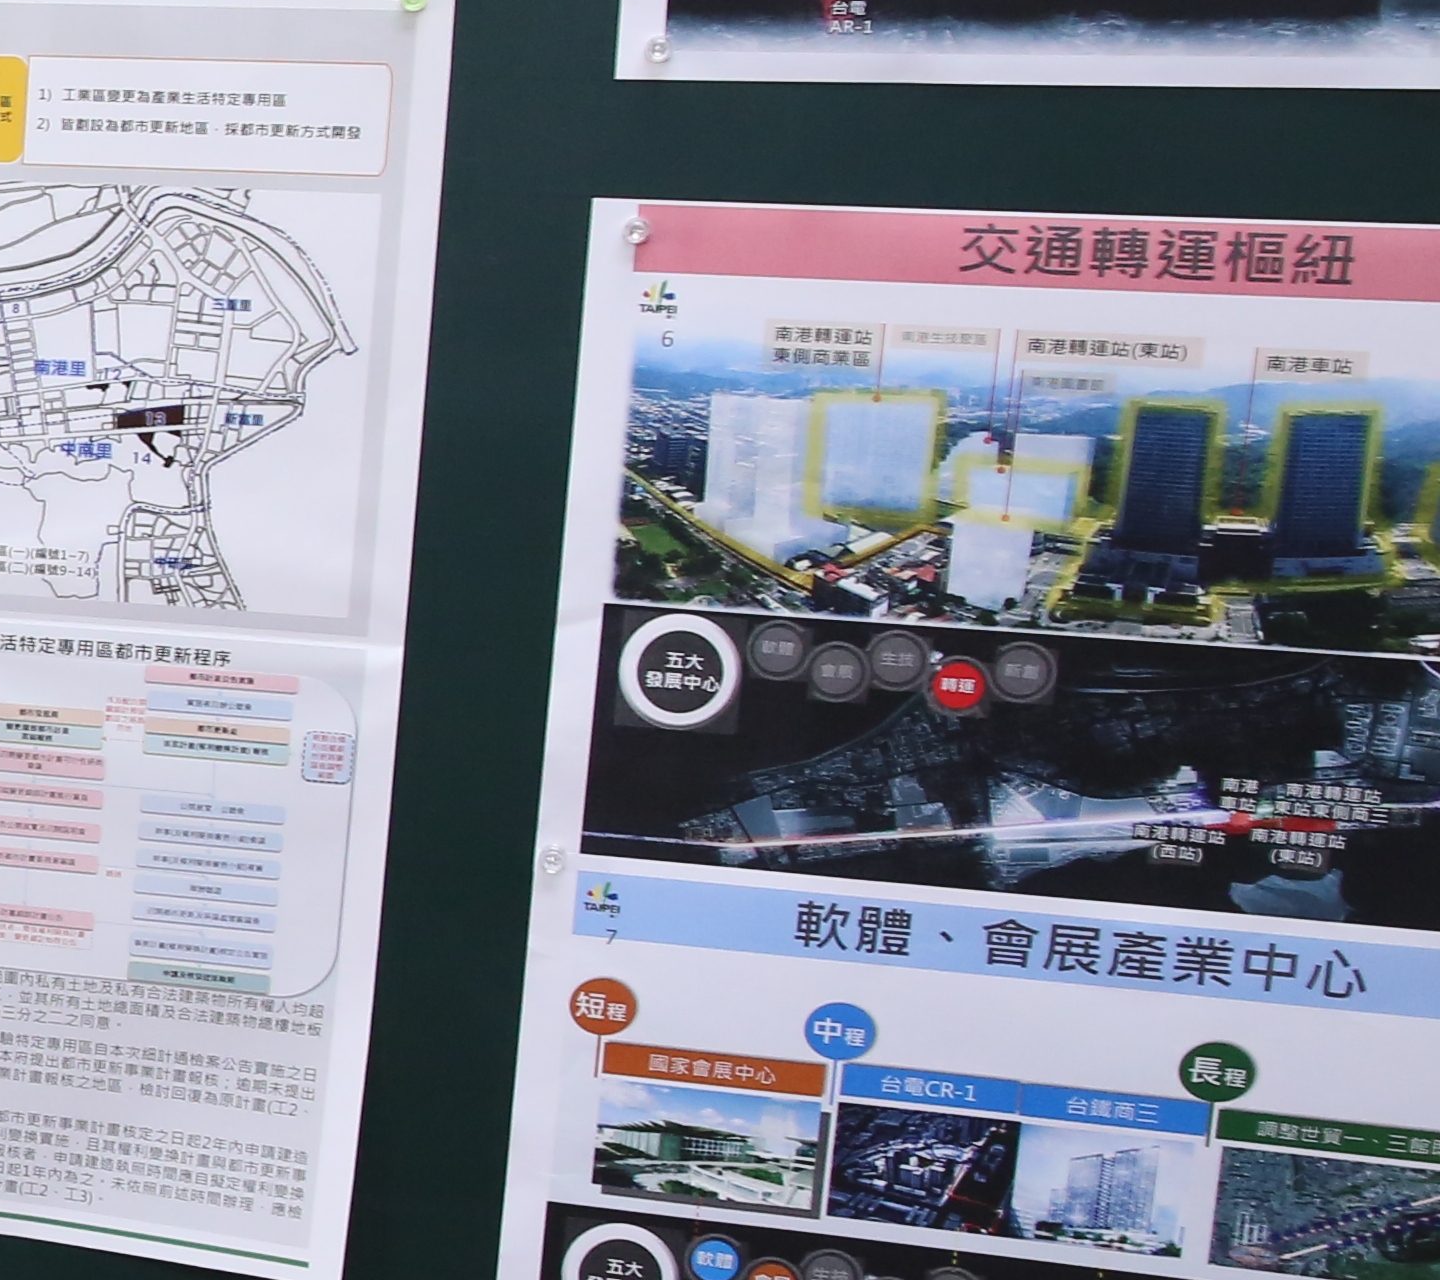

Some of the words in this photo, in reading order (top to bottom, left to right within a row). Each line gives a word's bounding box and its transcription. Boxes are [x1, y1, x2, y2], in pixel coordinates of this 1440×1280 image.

[831, 1, 868, 16] 台電
[829, 19, 873, 35] AR-1
[38, 88, 53, 102] 1)
[36, 117, 50, 131] 2)
[959, 225, 1356, 288] 交通轉運樞紐
[638, 303, 678, 316] TAIPEI
[661, 330, 674, 348] 6
[775, 326, 873, 346] 南港轉運站
[772, 347, 871, 367] 東側商業區
[1027, 334, 1187, 363] 南港轉運站(東站)
[33, 359, 86, 377] 南港里
[1266, 353, 1354, 377] 南港車站
[60, 442, 113, 460] 中南里
[664, 650, 705, 671] 五大
[880, 650, 914, 669] 生技
[1004, 660, 1039, 680] 新創
[644, 671, 720, 694] 發展中心
[939, 676, 976, 694] 轉運
[1222, 777, 1259, 795] 南港
[1286, 782, 1382, 804] 南港轉運站
[1220, 796, 1257, 812] 車站
[1133, 824, 1226, 846] 南港轉運站
[1250, 828, 1346, 850] 南港轉運站
[1152, 843, 1204, 863] (西站)
[1270, 848, 1323, 868] (東站)
[583, 901, 621, 918] TAIPEI
[604, 927, 618, 946] 7
[794, 900, 1368, 1002] 軟體、會展產業中心
[575, 990, 627, 1024] 短程
[812, 1016, 866, 1048] 中程
[647, 1051, 775, 1087] 國家會展中心
[1187, 1056, 1247, 1090] 長程
[880, 1074, 979, 1105] 台電CR-1
[1065, 1094, 1160, 1125] 台鐵商三
[605, 1255, 644, 1276] 五大
[696, 1250, 734, 1272] 軟體
